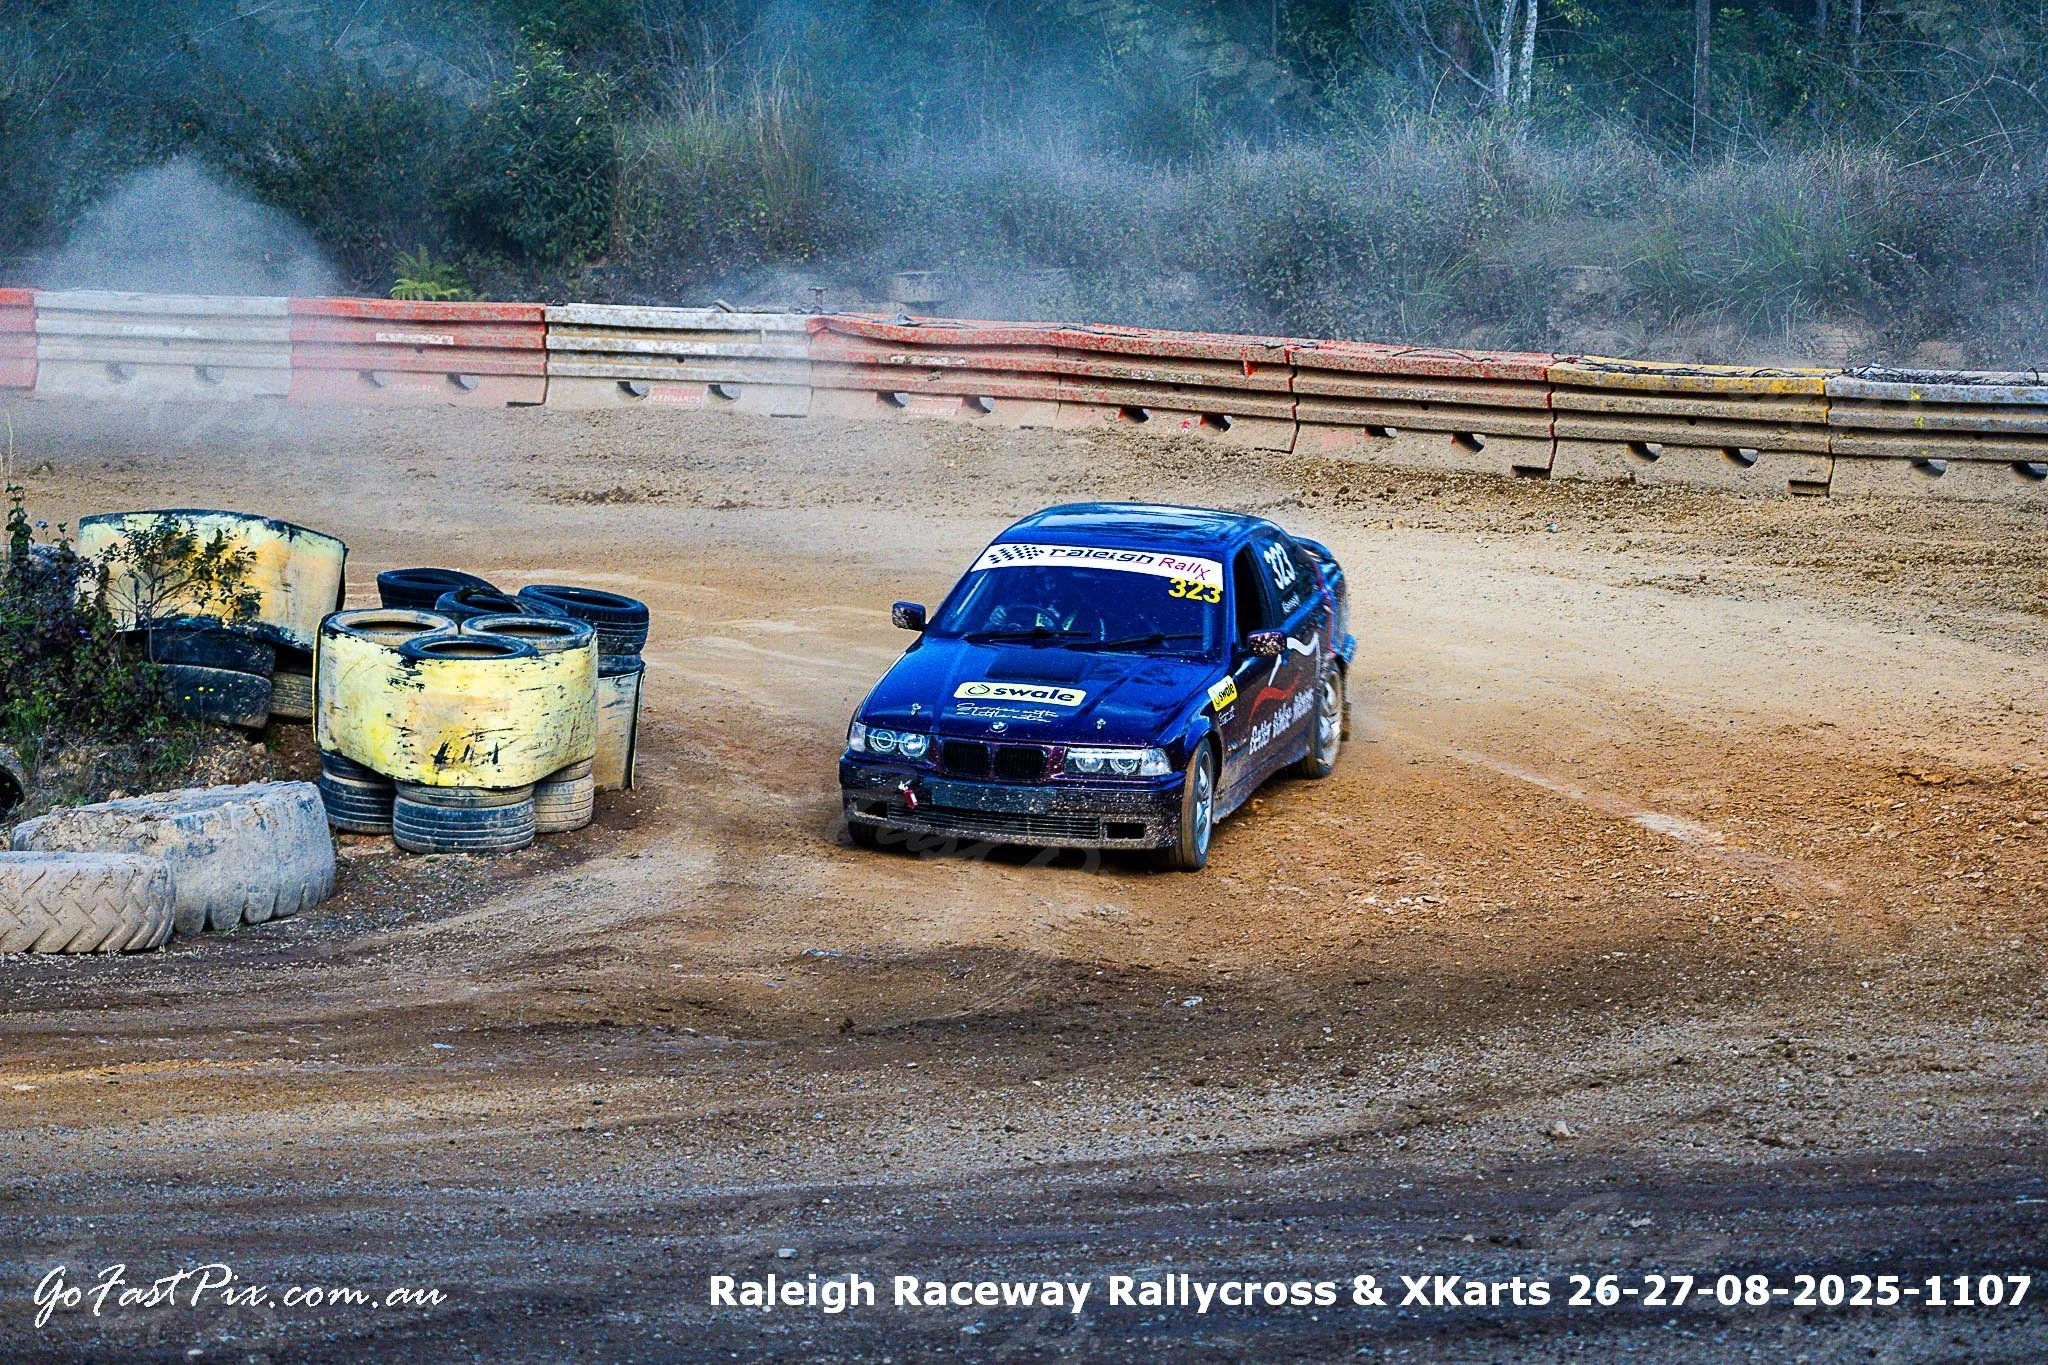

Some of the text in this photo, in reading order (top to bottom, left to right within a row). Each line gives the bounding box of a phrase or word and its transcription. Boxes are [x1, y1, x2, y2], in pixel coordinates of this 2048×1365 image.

[1049, 548, 1155, 565] raleigh
[1263, 542, 1296, 591] 323
[1168, 577, 1221, 604] 323
[993, 687, 1076, 702] swale
[1218, 680, 1235, 702] swale
